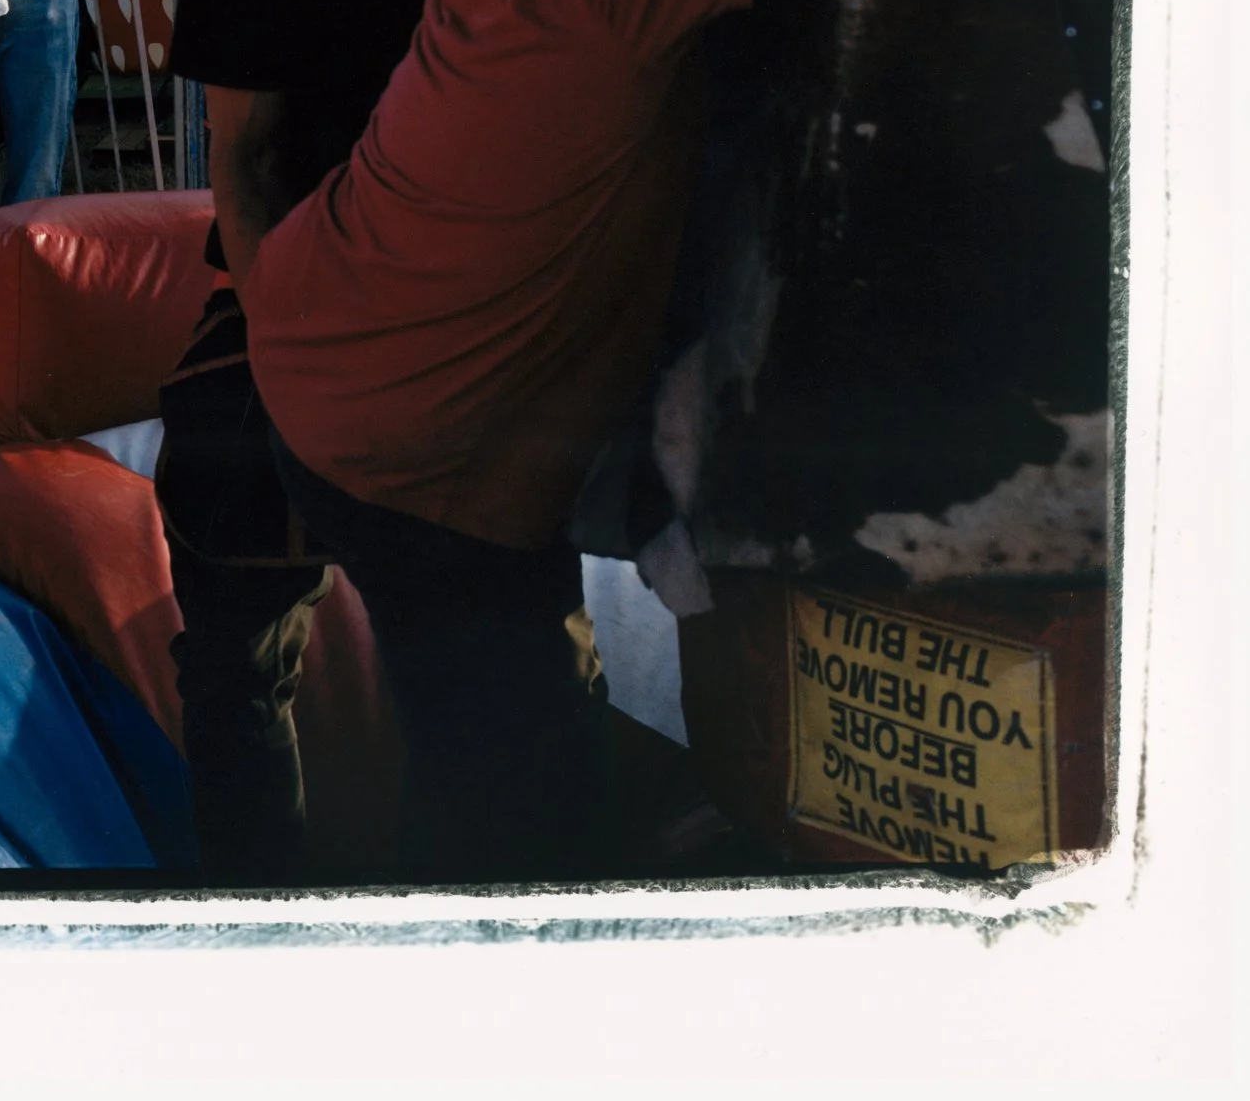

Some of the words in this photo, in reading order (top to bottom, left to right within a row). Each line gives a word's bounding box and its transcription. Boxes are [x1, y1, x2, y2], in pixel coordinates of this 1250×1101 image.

[815, 599, 908, 662] BULL
[915, 630, 991, 688] THE
[797, 637, 926, 721] REMOVE
[827, 702, 977, 788] BEFORE
[938, 691, 1033, 749] YOU
[822, 740, 902, 811] PLUG
